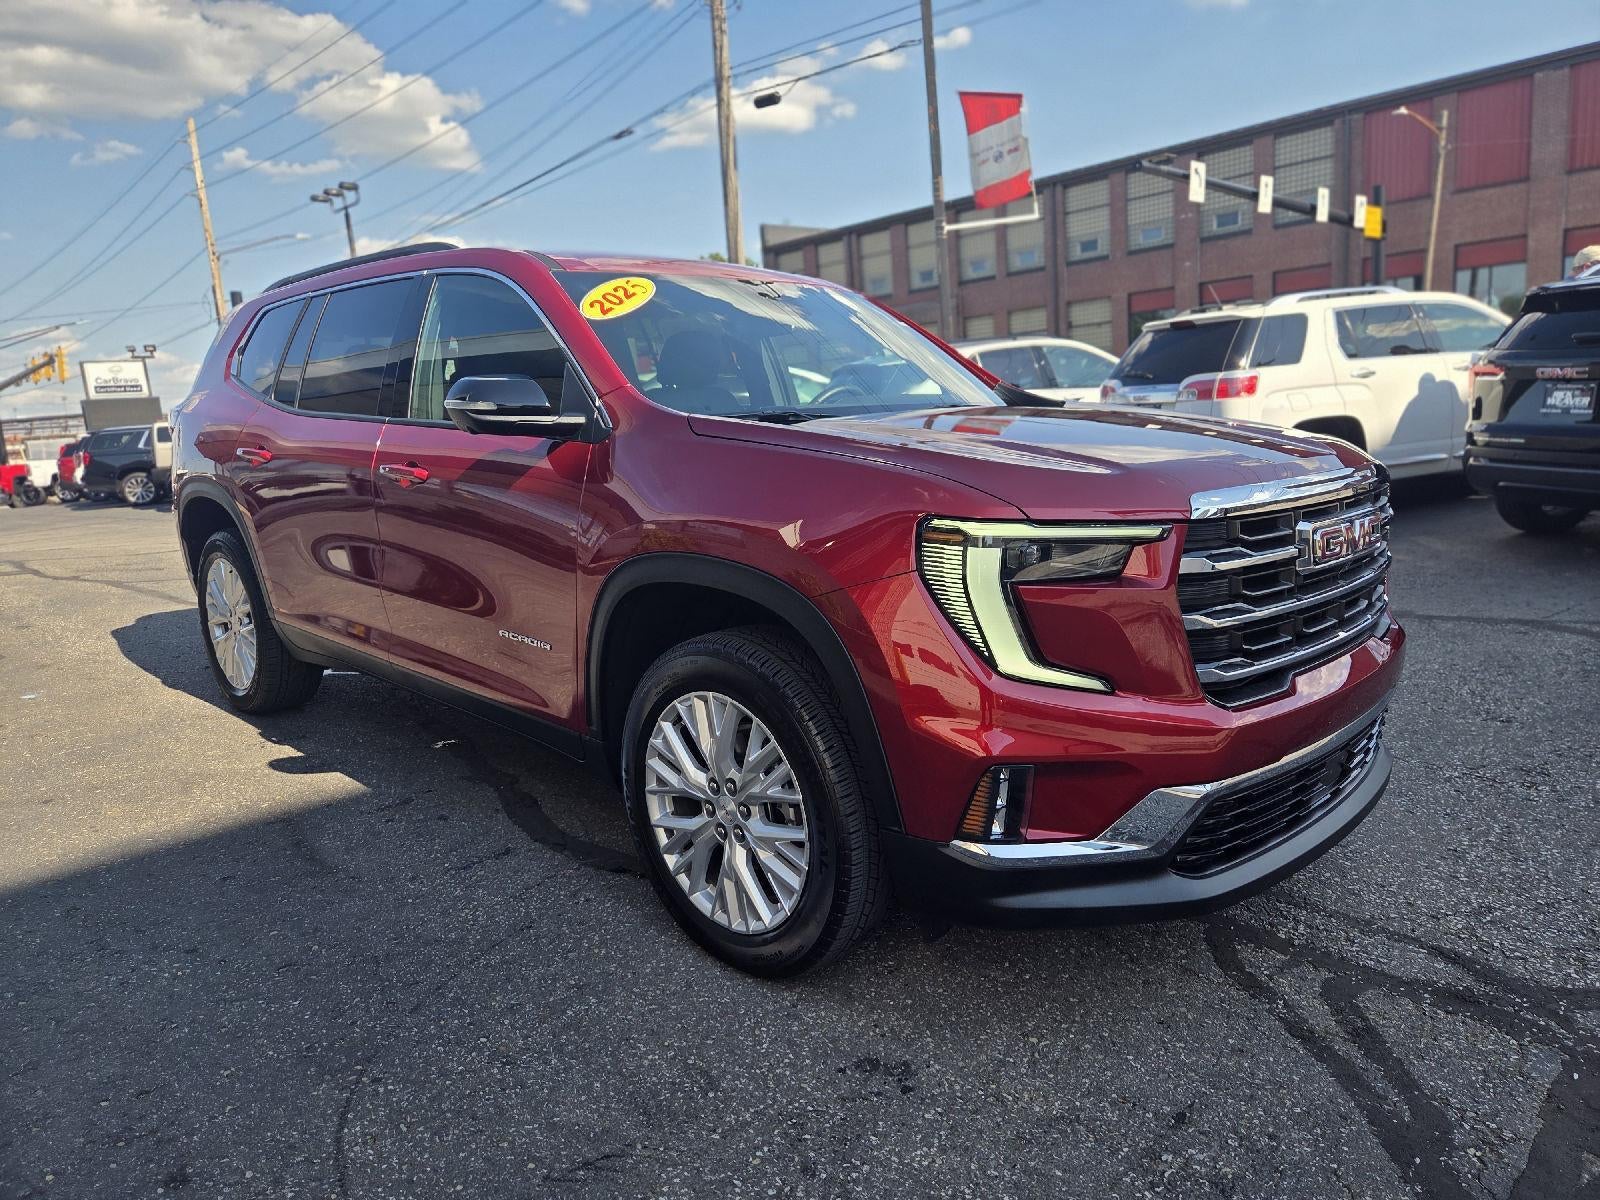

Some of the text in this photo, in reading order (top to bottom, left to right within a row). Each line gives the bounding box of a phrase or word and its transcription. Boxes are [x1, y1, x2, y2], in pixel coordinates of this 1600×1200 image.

[589, 279, 648, 315] 2025
[95, 376, 140, 384] CarBravo
[1536, 367, 1589, 378] GMC
[1315, 515, 1381, 561] GMC
[499, 629, 551, 651] ACADIA
